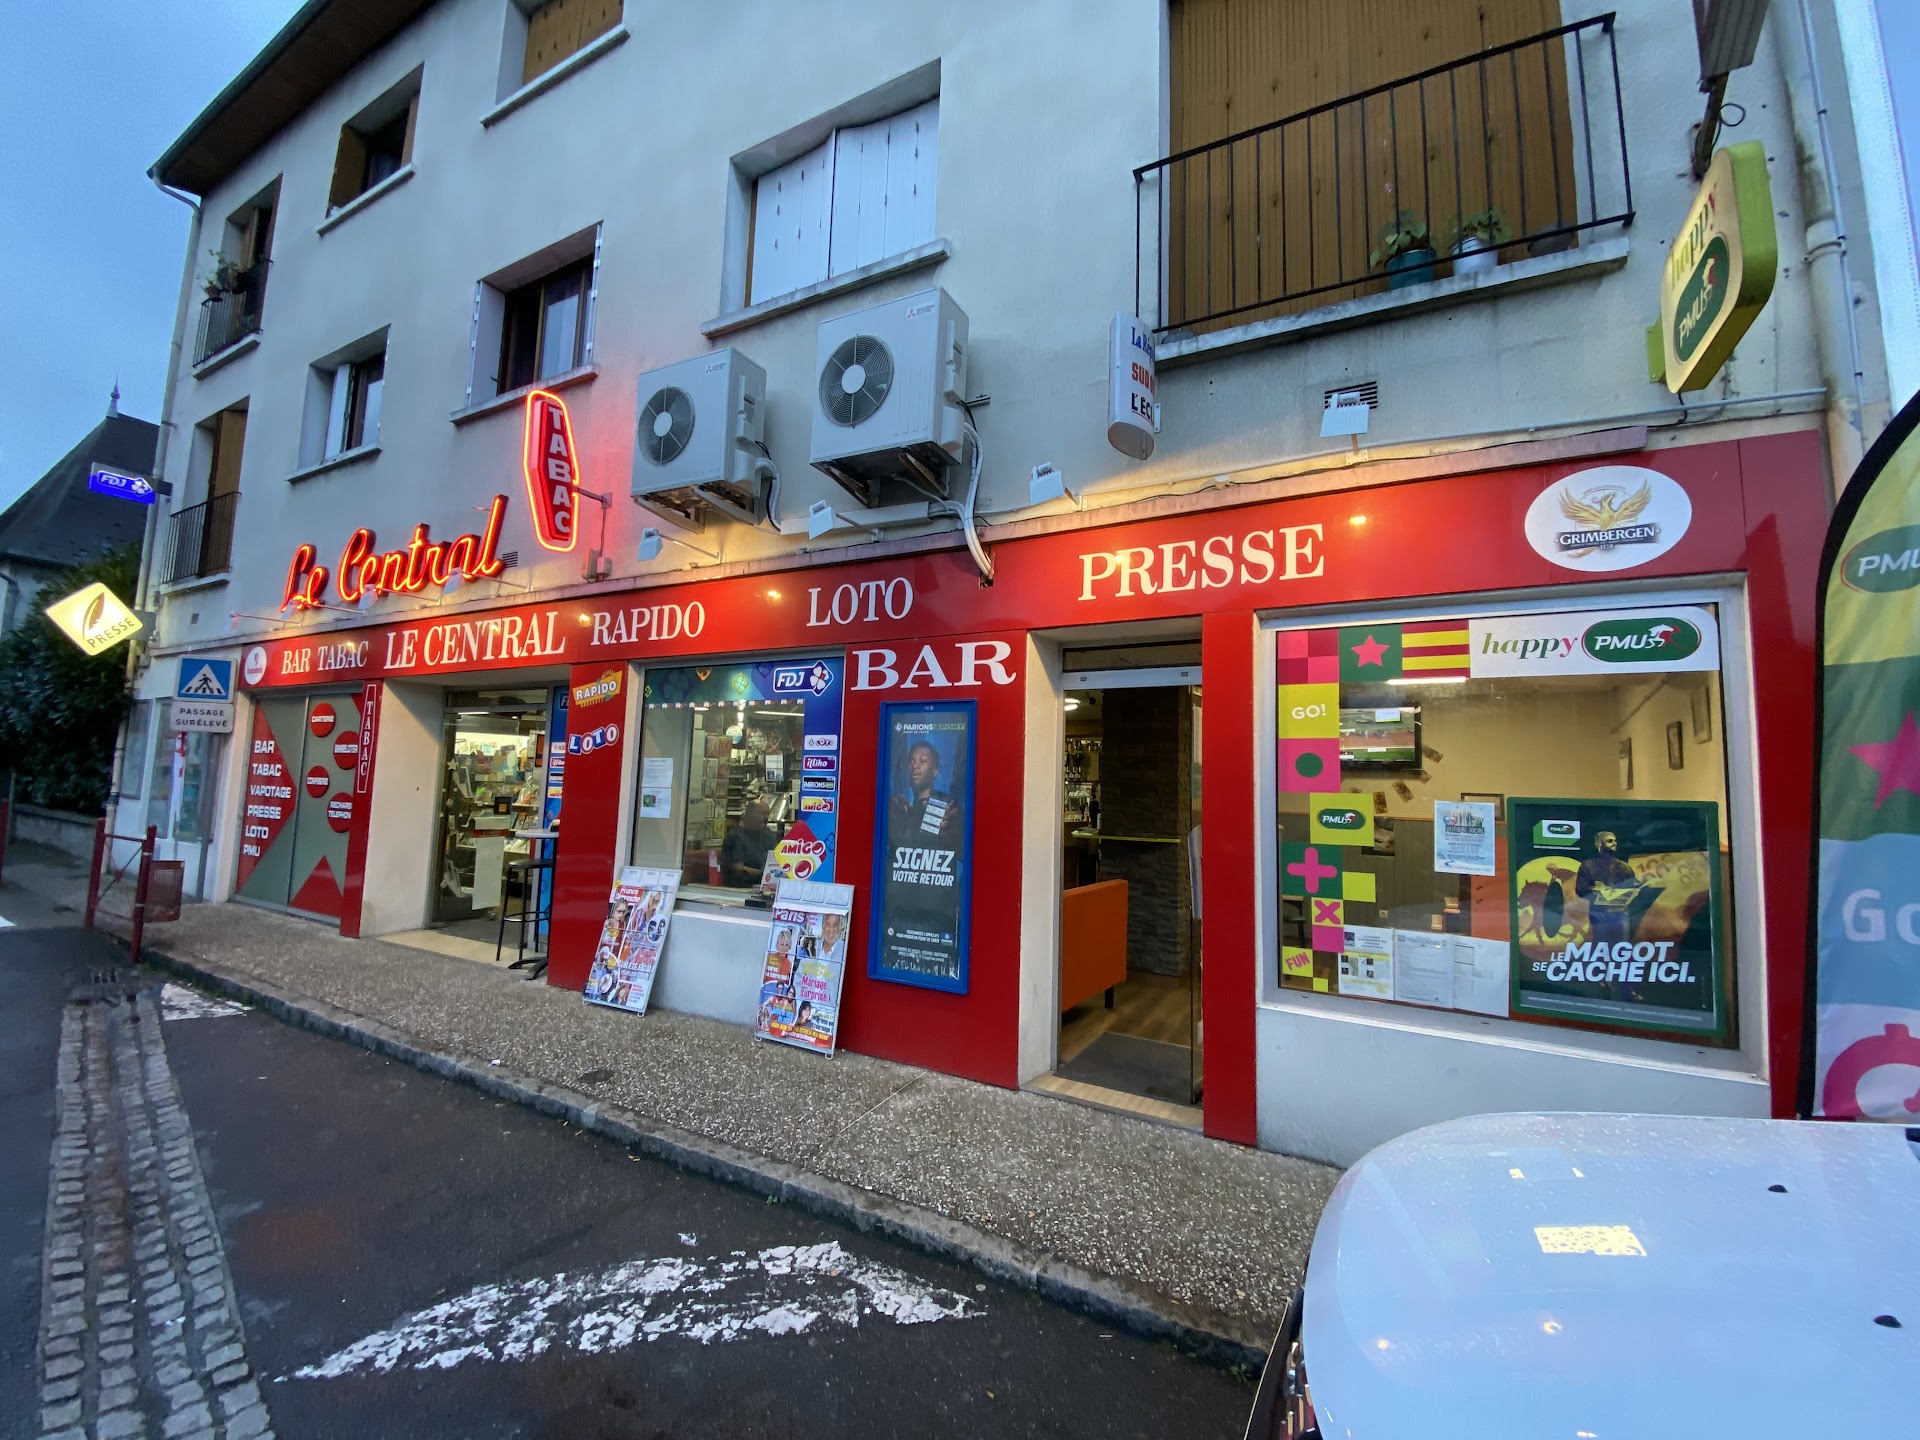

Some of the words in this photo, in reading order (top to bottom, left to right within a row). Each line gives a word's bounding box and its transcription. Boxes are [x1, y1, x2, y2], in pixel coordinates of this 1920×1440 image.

[1678, 290, 1705, 348] PMU
[547, 406, 572, 533] TABAC
[100, 475, 127, 487] FDJ
[1559, 526, 1655, 545] GRIMBERGEN
[281, 543, 331, 613] Le
[338, 494, 509, 603] Central
[281, 648, 311, 674] BAR
[317, 640, 369, 671] TABAC
[383, 629, 418, 669] LE
[424, 611, 566, 666] CENTRAL
[591, 601, 706, 646] RAPIDO
[806, 577, 914, 627] LOTO
[1077, 523, 1325, 601] PRESSE
[87, 617, 135, 648] PRESSE
[1481, 632, 1578, 660] happy
[1594, 634, 1649, 651] PMU
[851, 640, 1017, 691] BAR
[777, 671, 805, 688] FDJ
[576, 680, 617, 701] RAPIDO
[179, 707, 225, 716] PASSAGE
[1291, 703, 1327, 720] GO!
[175, 717, 228, 727] SURÉLEVÉ
[903, 723, 934, 731] PARIONS
[254, 740, 275, 753] BAR
[361, 701, 373, 776] TABAC
[569, 725, 618, 753] LOTO
[252, 763, 282, 777] TABAC
[250, 785, 292, 799] VAPOTAGE
[247, 805, 281, 819] PRESSE
[1322, 815, 1344, 824] PMU
[244, 827, 269, 840] LOTO
[243, 844, 261, 857] PMU
[893, 846, 955, 873] SIGNEZ
[892, 870, 919, 884] VOTRE
[919, 872, 954, 887] RETOUR
[1550, 952, 1564, 961] LE
[1564, 941, 1675, 962] MAGOT
[1285, 951, 1311, 971] FUN
[1532, 961, 1547, 972] SE
[1546, 961, 1646, 982] CACHE
[1648, 962, 1696, 983] ICI.
[801, 976, 827, 991] Mariage
